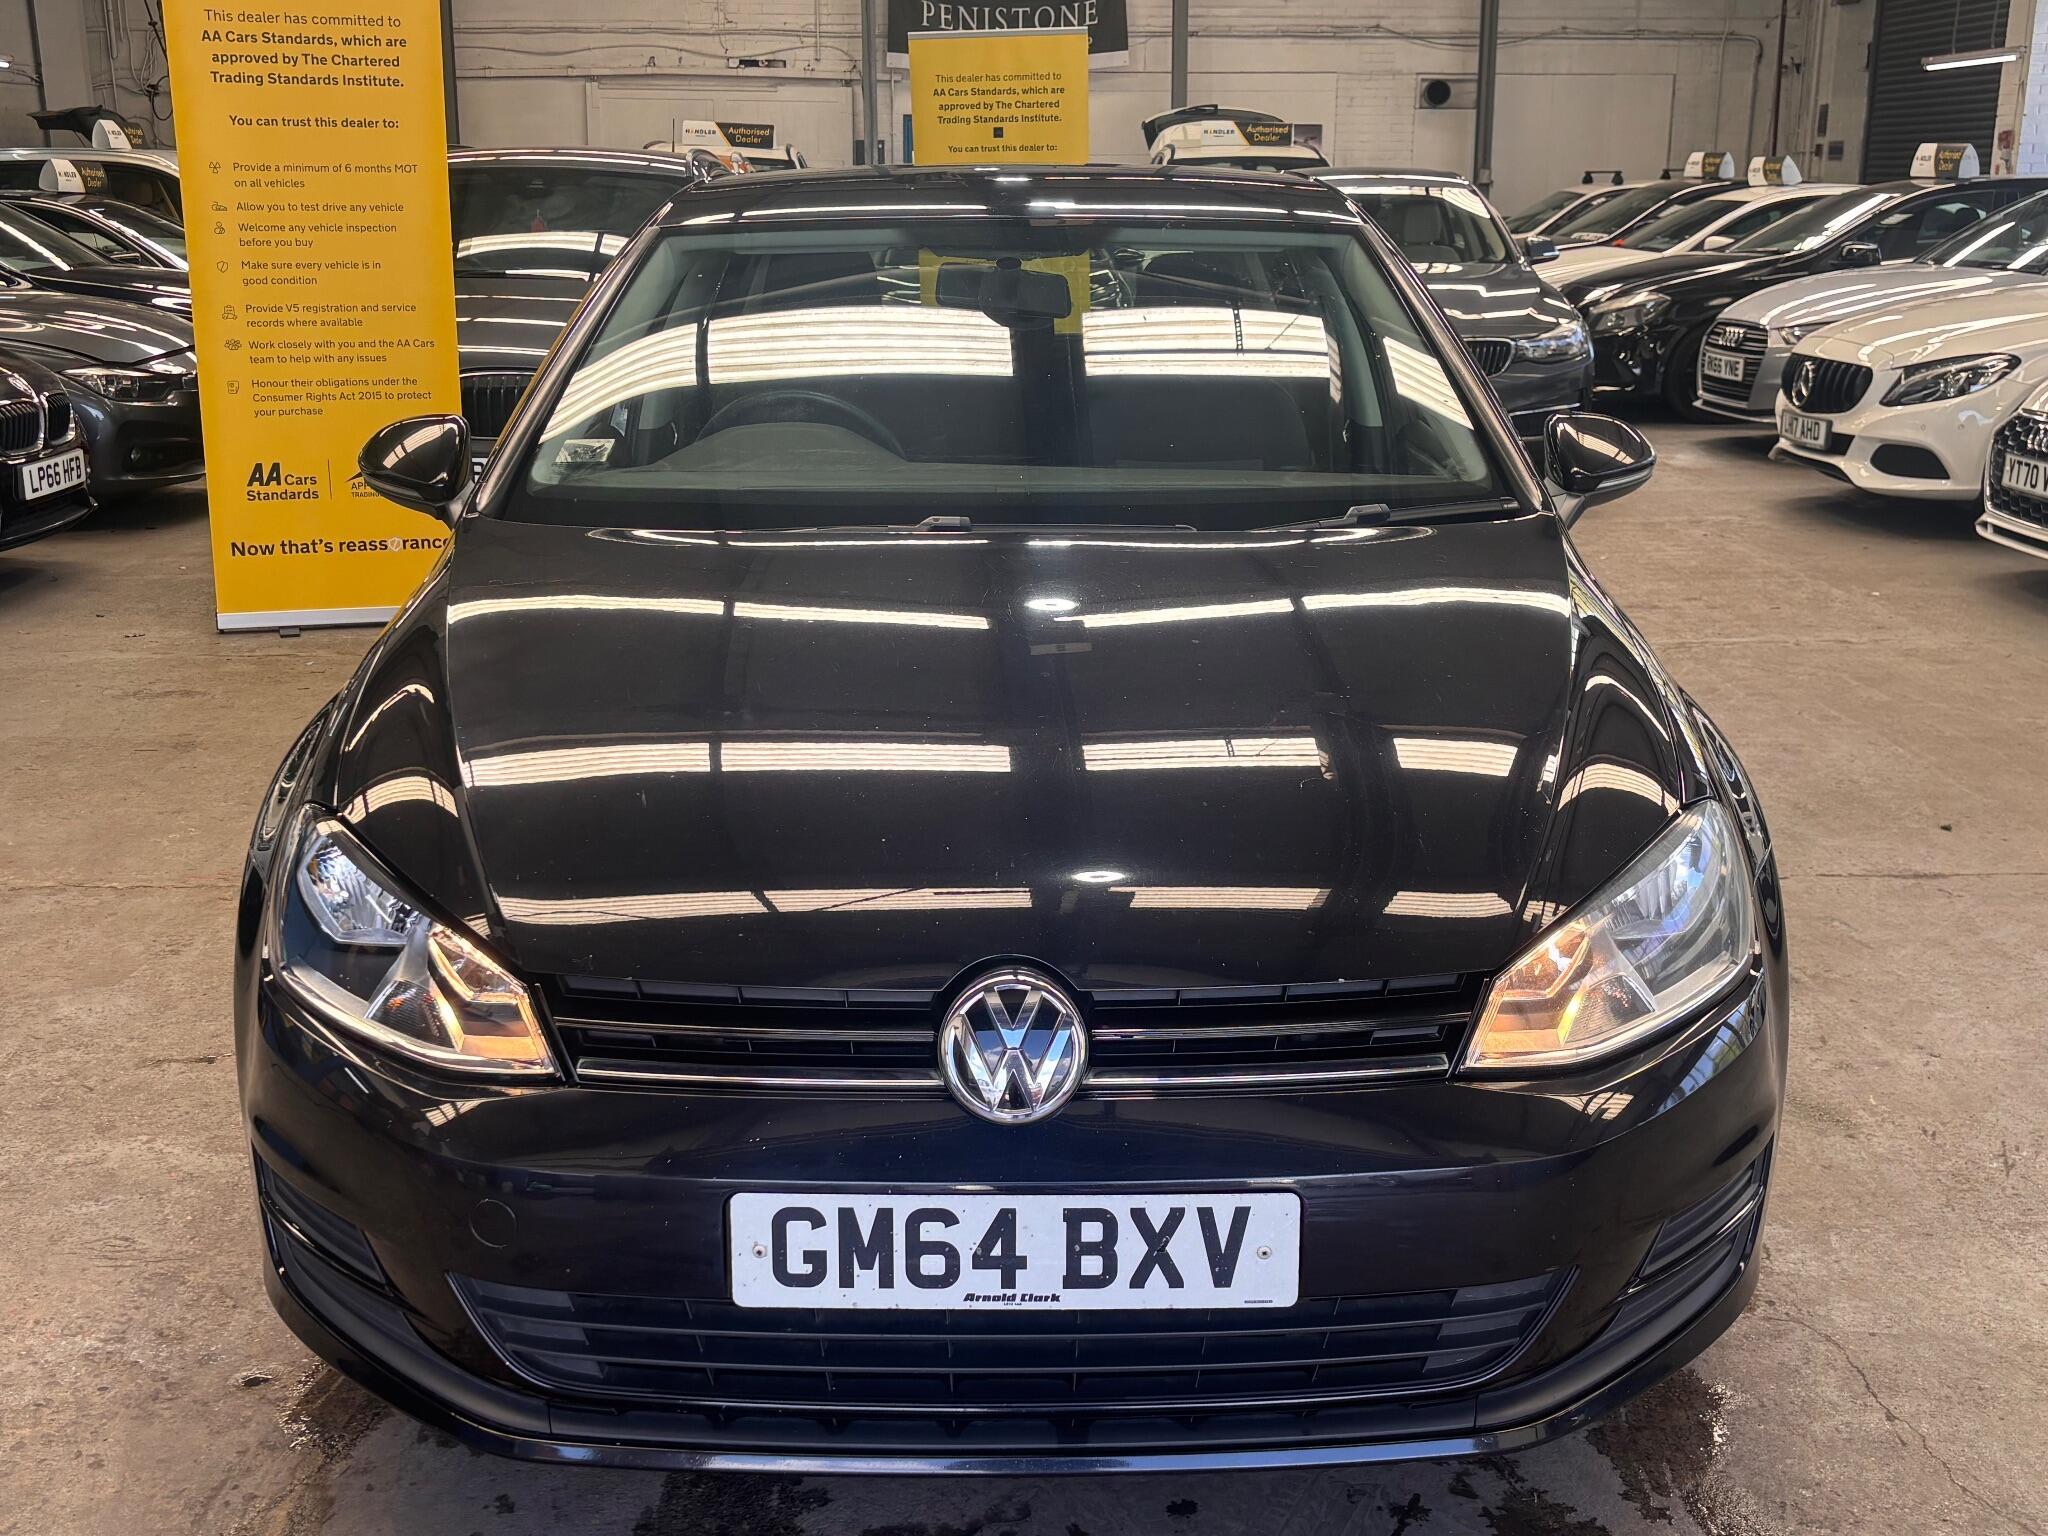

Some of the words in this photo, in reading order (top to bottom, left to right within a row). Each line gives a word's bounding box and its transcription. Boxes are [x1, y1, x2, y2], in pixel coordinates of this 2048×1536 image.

[203, 9, 233, 22] This
[237, 10, 280, 23] dealer
[284, 12, 307, 24] has
[311, 14, 383, 26] committed
[387, 15, 401, 28] to
[921, 0, 1098, 31] PENISTONE
[201, 29, 222, 42] AA
[225, 30, 258, 43] Cars
[261, 31, 337, 47] Standards,
[340, 34, 381, 46] which
[385, 38, 406, 47] are
[211, 52, 278, 66] approved
[282, 52, 298, 67] by
[301, 53, 327, 65] The
[331, 54, 400, 67] Chartered
[209, 70, 263, 86] Trading
[267, 72, 338, 85] Standards
[342, 74, 404, 87] Institute.
[935, 74, 954, 83] This
[955, 73, 984, 82] dealer
[985, 73, 1000, 82] has
[1002, 72, 1050, 81] committed
[1052, 72, 1062, 80] to
[932, 88, 946, 96] AA
[947, 87, 968, 96] Cars
[970, 86, 1019, 96] Standards,
[1021, 86, 1048, 94] which
[938, 101, 980, 112] approved
[983, 101, 994, 111] by
[995, 101, 1012, 109] The
[1014, 99, 1059, 108] Chartered
[229, 114, 252, 126] You
[256, 118, 278, 126] can
[281, 116, 311, 127] trust
[314, 116, 337, 127] this
[340, 117, 379, 128] dealer
[382, 118, 398, 128] to:
[937, 115, 971, 125] Trading
[973, 114, 1019, 123] Standards
[1021, 114, 1062, 122] Institute.
[728, 126, 770, 136] Authorised
[1246, 124, 1289, 134] Authorised
[735, 134, 762, 144] Dealer
[1001, 144, 1017, 152] this
[1046, 143, 1057, 151] to:
[232, 162, 271, 172] Provide
[274, 164, 280, 172] a
[283, 162, 329, 172] minimum
[332, 163, 342, 172] of
[344, 163, 352, 172] 6
[354, 164, 392, 173] months
[394, 164, 418, 173] MOT
[249, 178, 262, 187] all
[264, 178, 305, 188] vehicles
[236, 201, 264, 211] Allow
[266, 204, 285, 213] you
[287, 202, 298, 212] to
[300, 202, 320, 211] test
[322, 202, 347, 211] drive
[349, 204, 366, 213] any
[369, 202, 404, 212] vehicle
[237, 222, 285, 232] Welcome
[288, 224, 305, 234] any
[308, 223, 343, 232] vehicle
[346, 223, 396, 233] inspection
[239, 237, 272, 246] before
[274, 239, 292, 248] you
[294, 238, 313, 248] buy
[241, 260, 268, 270] Make
[295, 262, 322, 271] every
[324, 260, 359, 269] vehicle
[362, 260, 370, 269] is
[372, 260, 381, 269] in
[242, 275, 268, 286] good
[270, 275, 317, 285] condition
[245, 303, 283, 313] Provide
[285, 303, 299, 312] V5
[302, 303, 358, 314] registration
[360, 303, 378, 312] and
[381, 303, 416, 312] service
[246, 318, 284, 327] records
[286, 318, 317, 327] where
[320, 318, 362, 326] available
[248, 340, 275, 349] Work
[277, 340, 312, 350] closely
[314, 339, 335, 348] with
[337, 341, 355, 350] you
[358, 339, 376, 348] and
[378, 338, 394, 348] the
[396, 338, 410, 348] AA
[412, 338, 434, 348] Cars
[249, 355, 274, 364] team
[276, 354, 287, 363] to
[289, 354, 311, 364] help
[313, 354, 334, 362] with
[337, 355, 354, 364] any
[356, 353, 387, 362] issues
[251, 379, 288, 388] Honour
[290, 378, 313, 387] their
[315, 377, 369, 388] obligations
[371, 377, 400, 386] under
[402, 376, 417, 385] the
[252, 393, 303, 402] Consumer
[306, 392, 337, 402] Rights
[339, 391, 355, 400] Act
[358, 391, 382, 400] 2015
[384, 391, 394, 400] to
[396, 391, 432, 400] protect
[253, 409, 276, 418] your
[278, 407, 323, 417] purchase
[28, 462, 60, 494] LP66
[62, 456, 82, 484] HFB
[247, 462, 282, 486] AA
[284, 474, 318, 486] Cars
[2008, 457, 2040, 490] YT70
[246, 488, 320, 501] Standards
[231, 542, 274, 556] Now
[280, 538, 334, 554] that’s
[771, 1206, 1028, 1290] GM64
[1062, 1206, 1252, 1288] BXV
[963, 1292, 1017, 1302] Arnold
[1020, 1292, 1061, 1302] Clark
